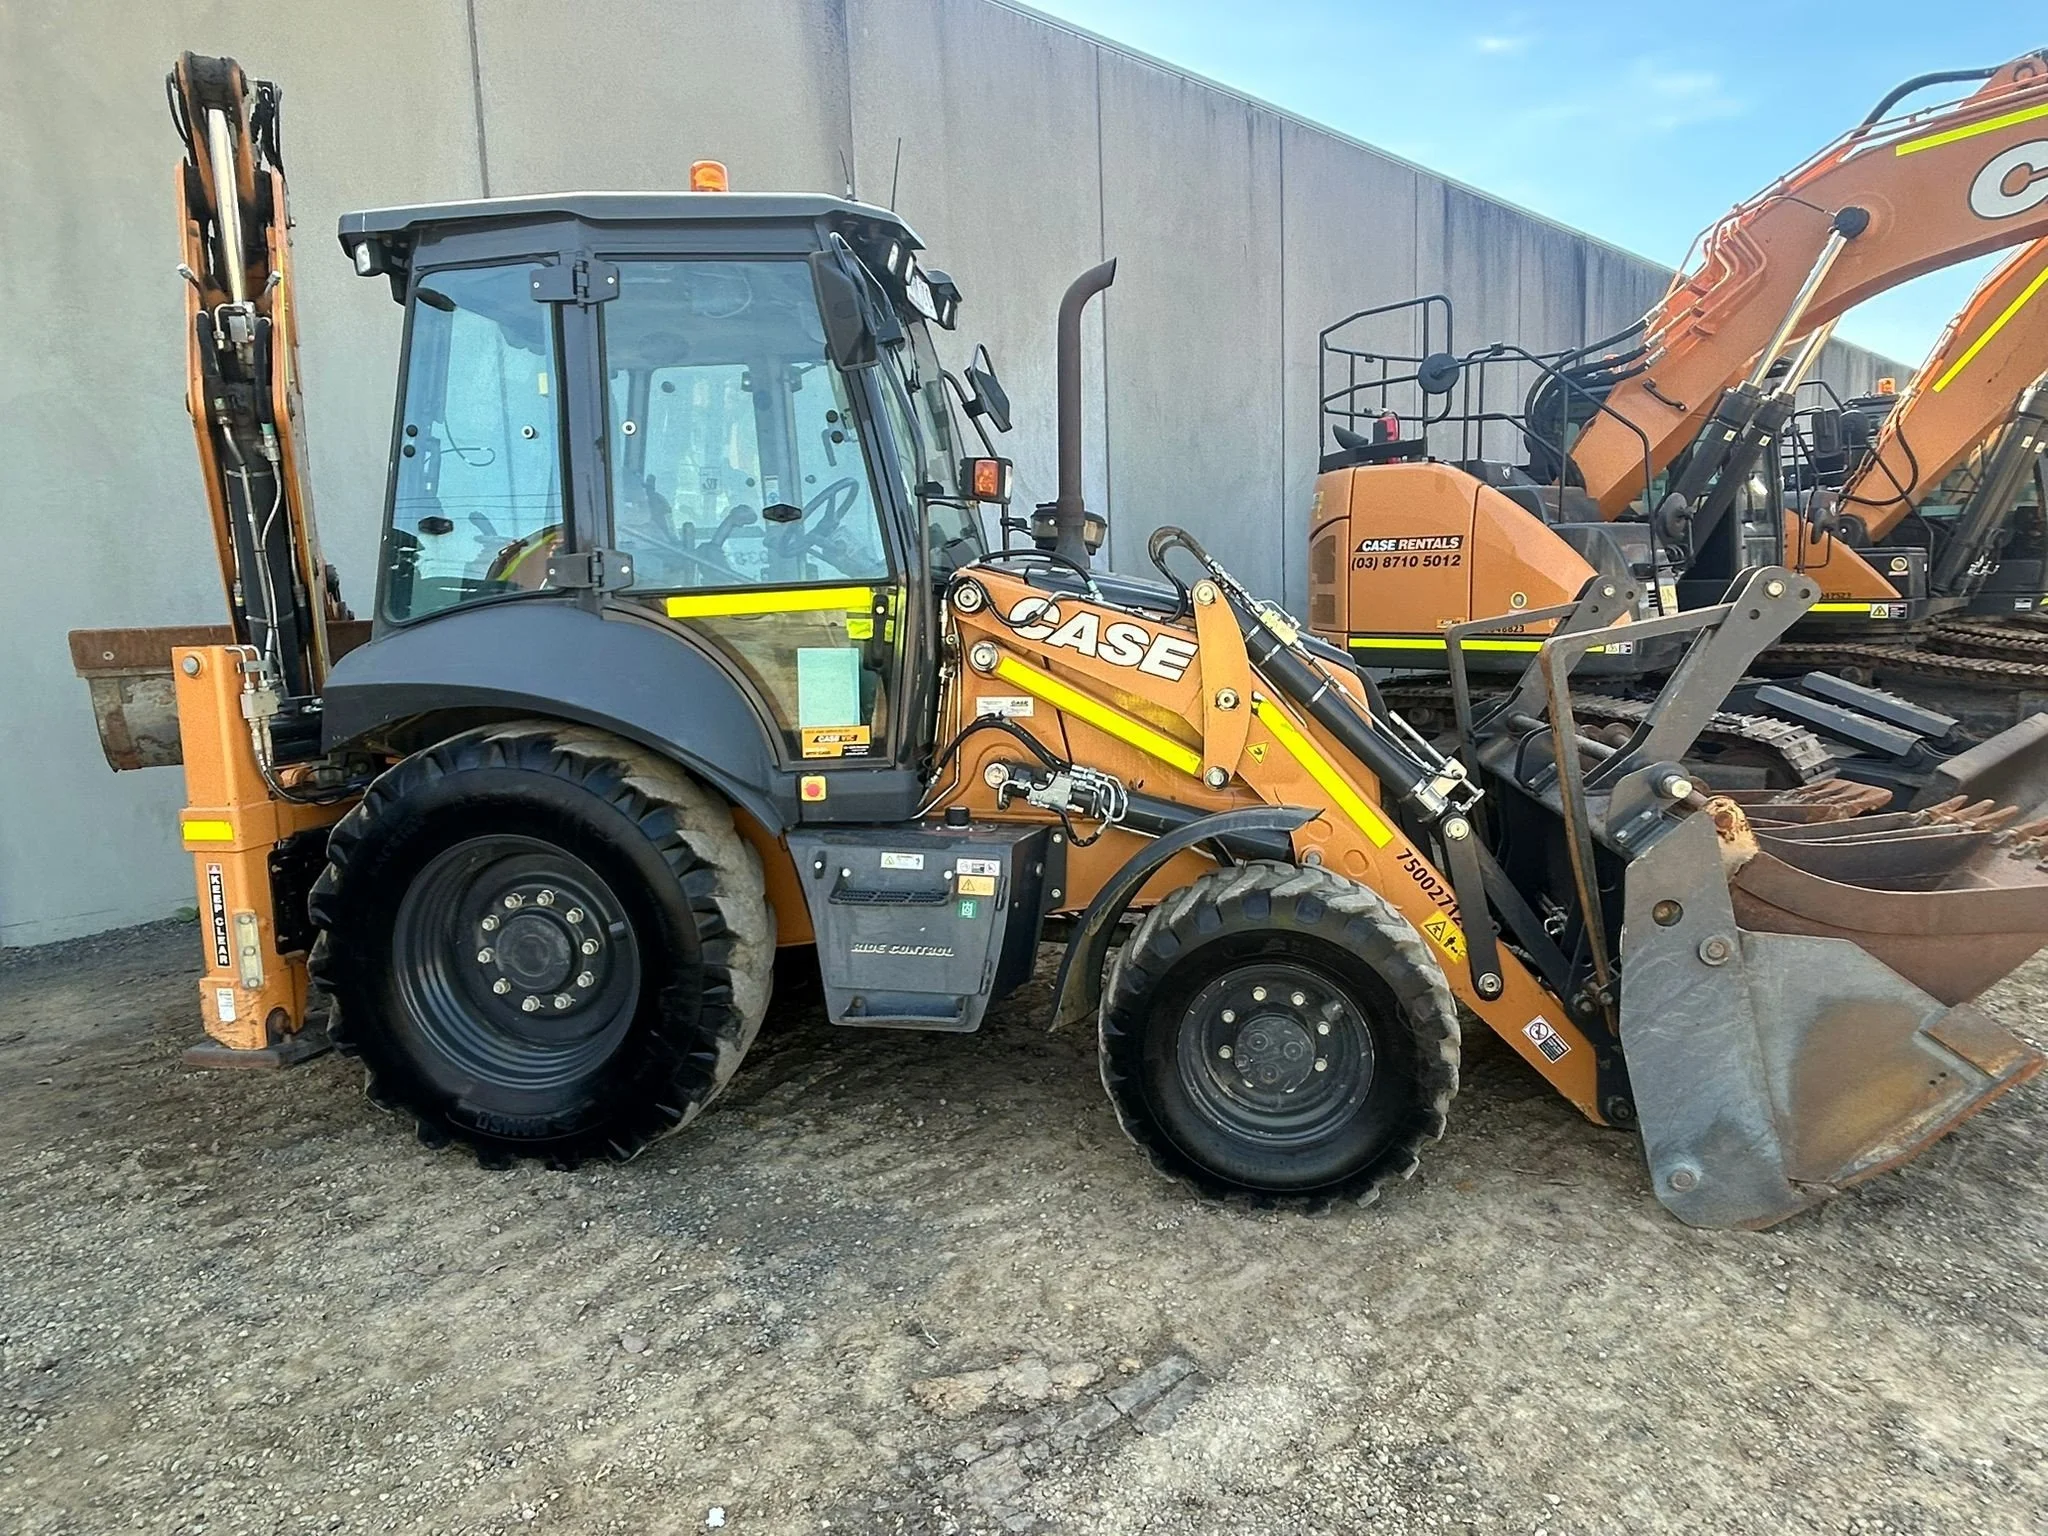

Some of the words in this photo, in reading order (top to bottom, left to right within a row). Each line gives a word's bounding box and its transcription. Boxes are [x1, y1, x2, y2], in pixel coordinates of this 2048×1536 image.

[1362, 539, 1396, 552] CASE
[1398, 537, 1459, 550] RENTALS
[1351, 557, 1378, 571] (03)
[1382, 555, 1419, 568] 8710
[1422, 554, 1461, 567] 5012
[1008, 596, 1200, 683] CASE
[210, 875, 222, 913] KEEP
[215, 917, 230, 965] CLEAR
[850, 943, 887, 954] RIDE
[888, 944, 955, 957] CONTROL
